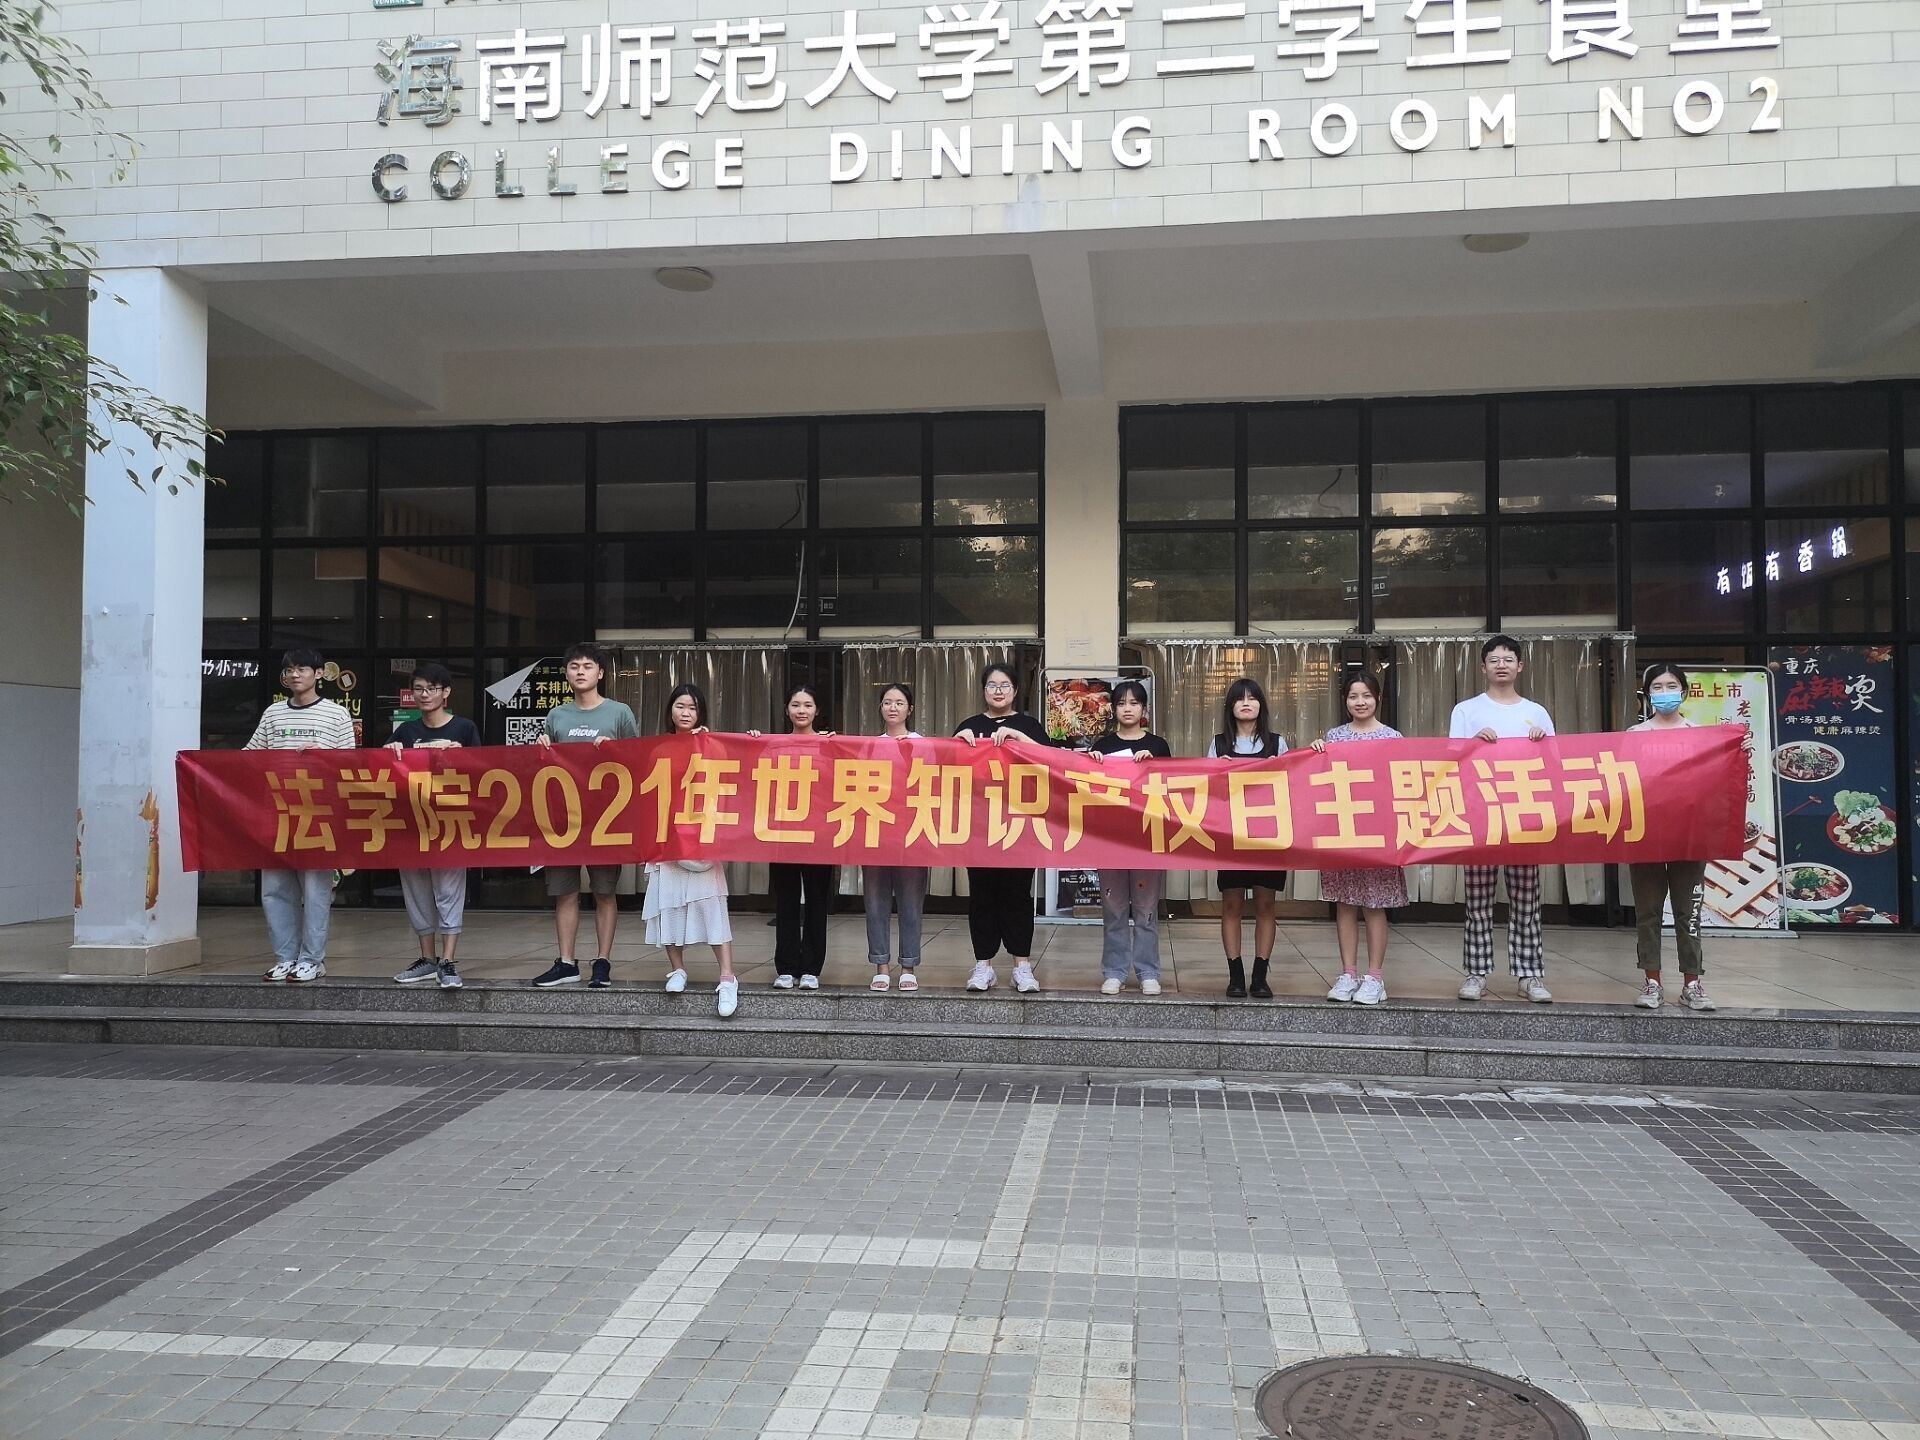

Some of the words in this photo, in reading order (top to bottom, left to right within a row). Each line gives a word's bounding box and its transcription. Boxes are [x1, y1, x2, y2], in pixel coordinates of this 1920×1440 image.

[370, 138, 745, 203] COLLEGE
[829, 117, 1153, 184] DINING
[1248, 93, 1516, 162] ROOM
[1597, 77, 1782, 142] NO2
[1782, 657, 1820, 675] 重庆
[535, 681, 574, 694] 不排队
[1813, 726, 1881, 735] 健康麻辣烫
[264, 752, 1646, 858] 法学院2021年世界知识产权日主题活动
